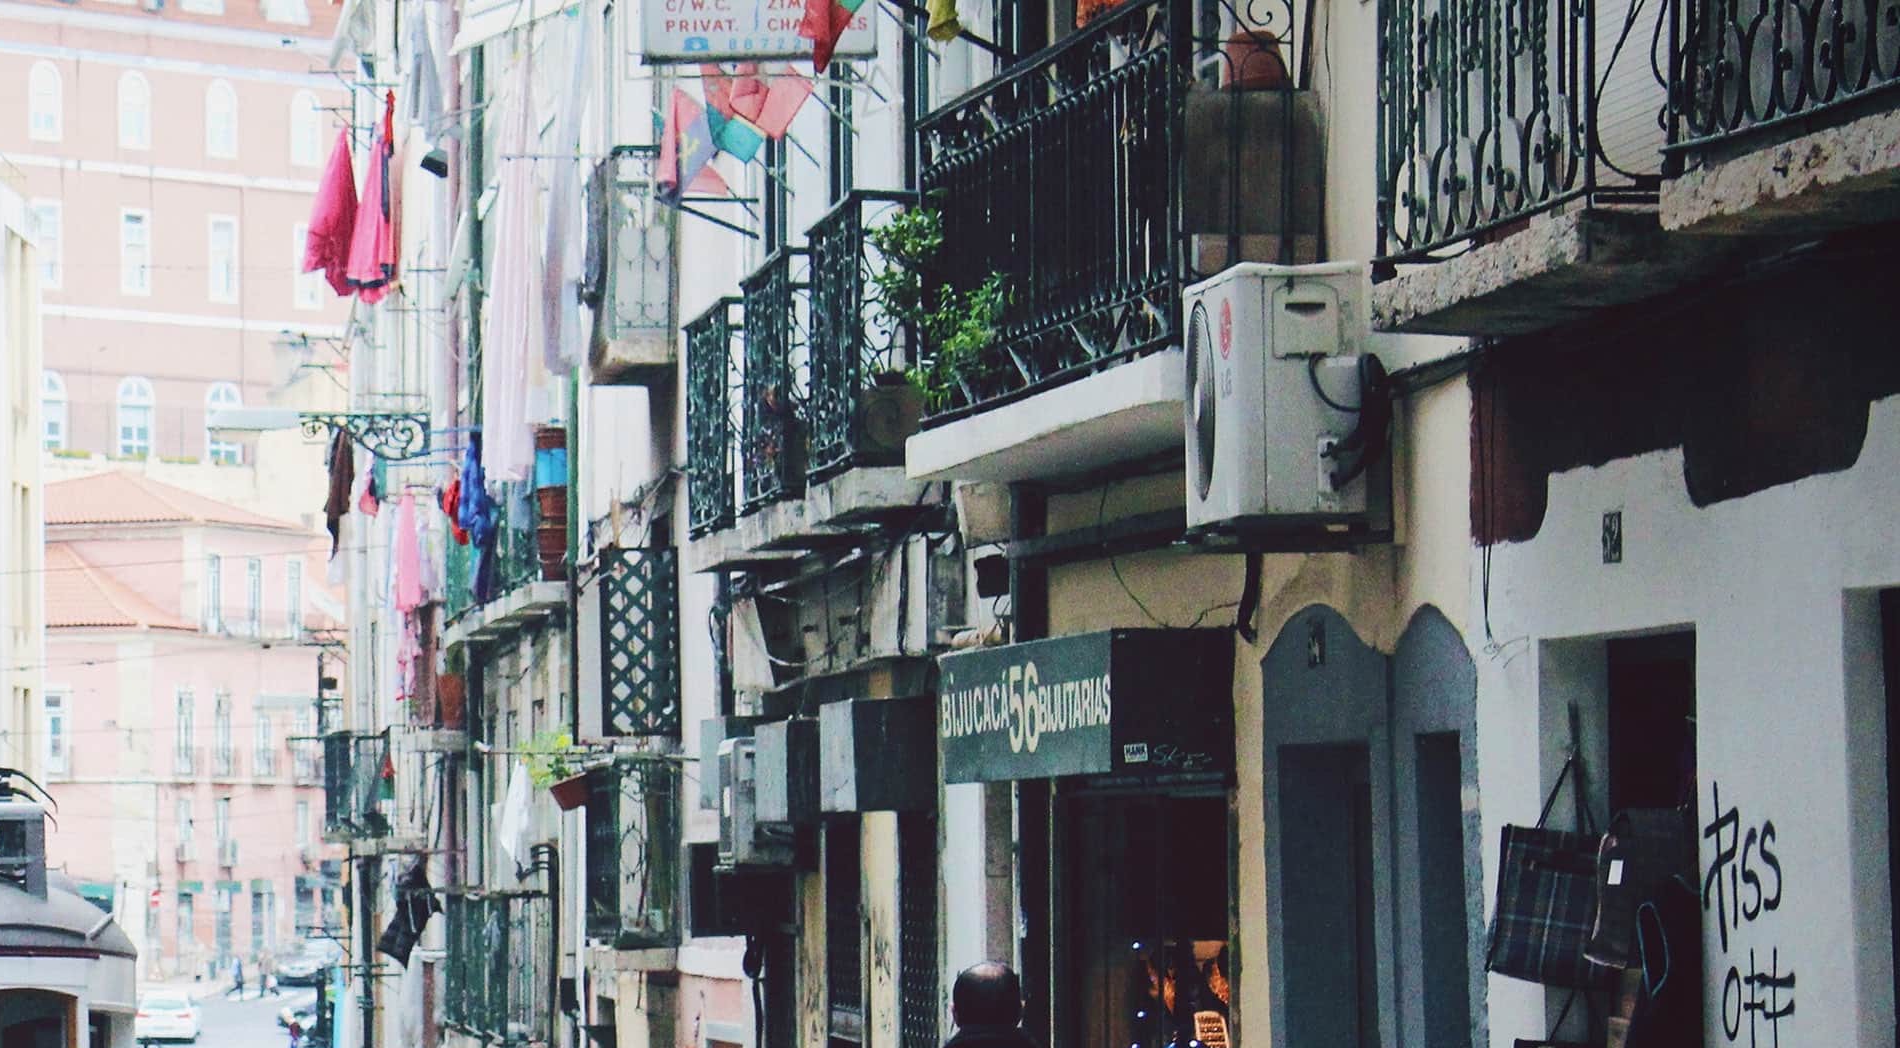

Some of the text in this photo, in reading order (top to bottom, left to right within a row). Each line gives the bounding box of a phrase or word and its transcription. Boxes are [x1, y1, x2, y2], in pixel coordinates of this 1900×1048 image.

[665, 18, 739, 33] PRIVAT.
[1009, 661, 1040, 753] 56
[1038, 673, 1112, 733] BIJUTARIAS
